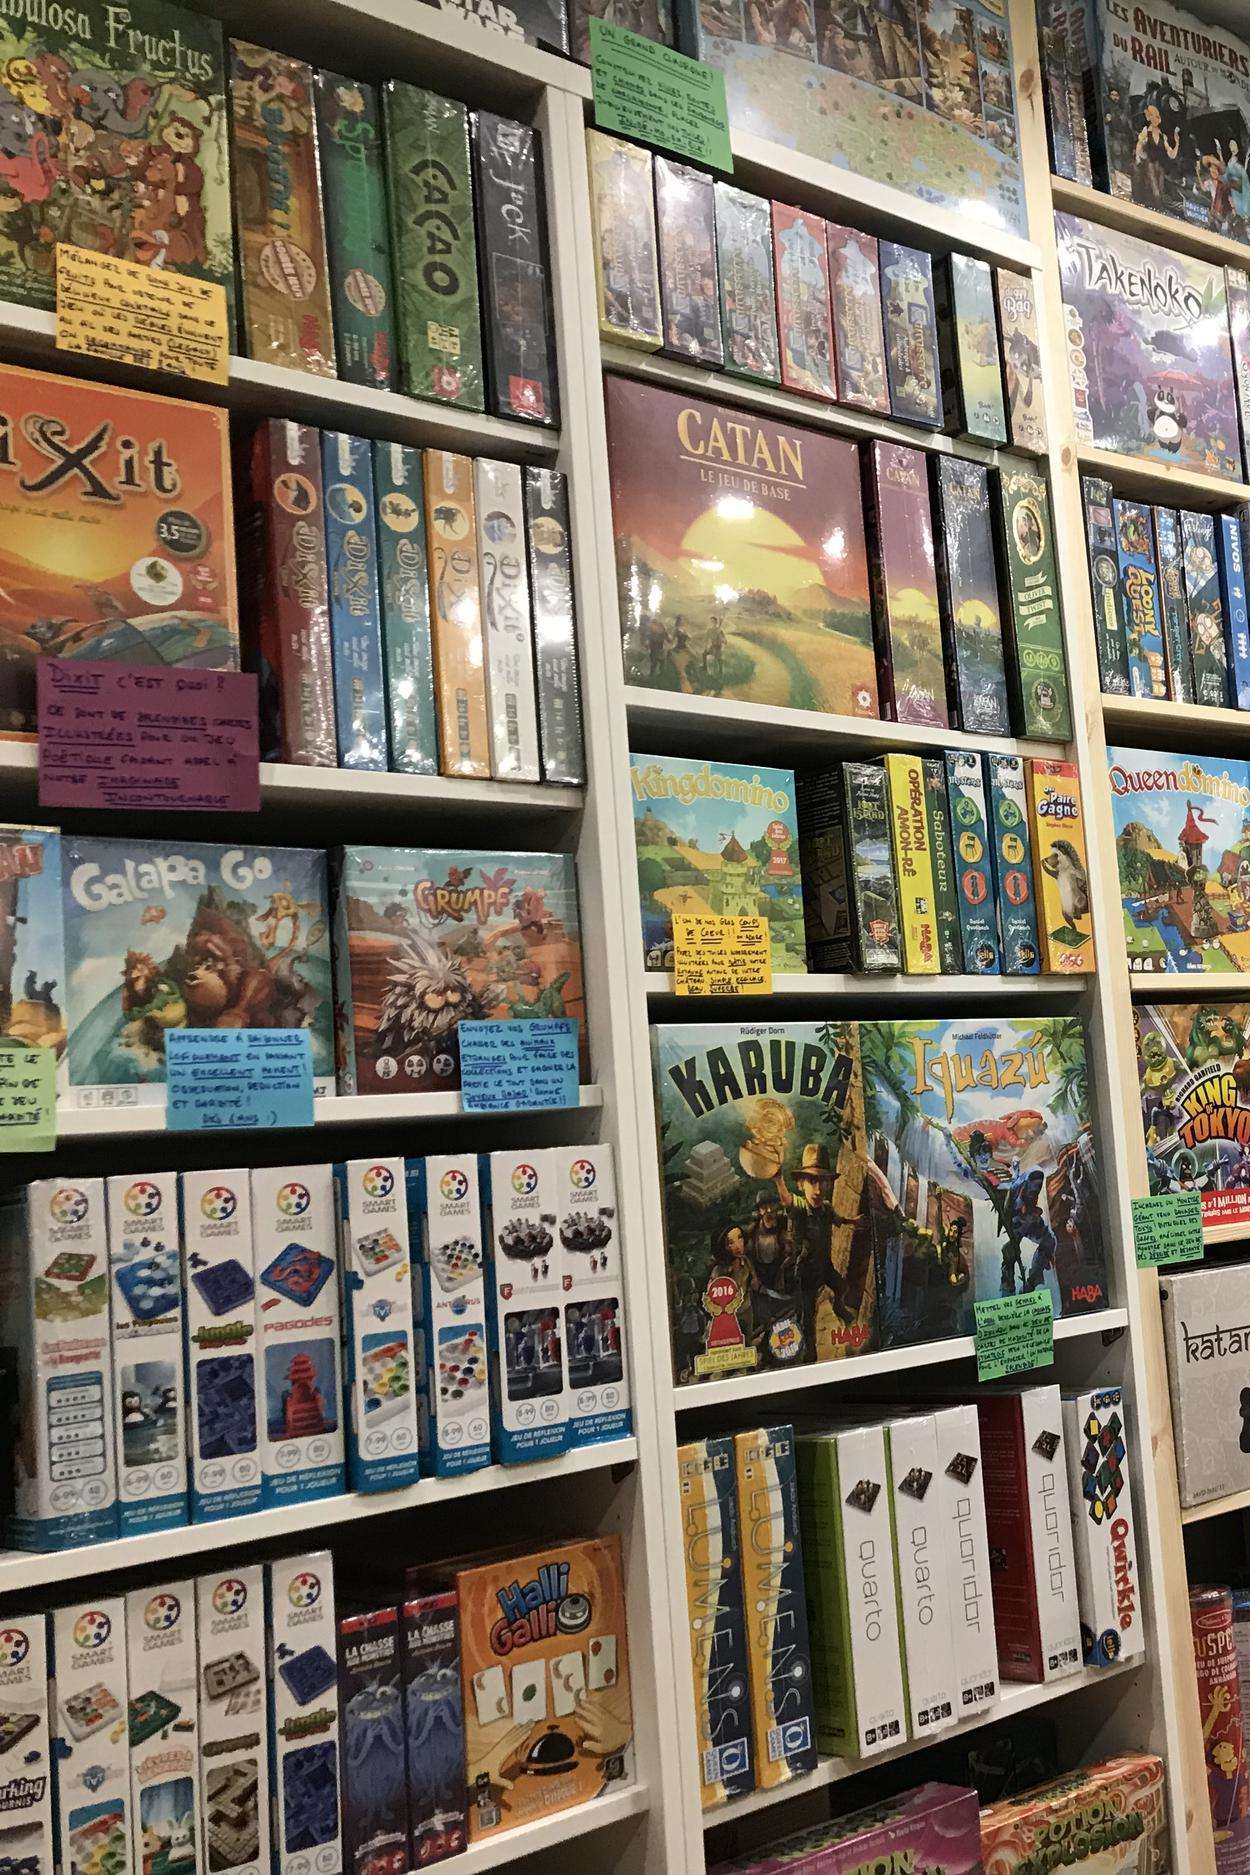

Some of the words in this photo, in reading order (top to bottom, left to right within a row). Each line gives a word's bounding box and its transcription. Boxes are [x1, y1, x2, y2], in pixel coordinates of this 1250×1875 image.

[0, 0, 92, 40] bulosa
[104, 5, 214, 81] Fructus
[1106, 0, 1129, 23] LES
[1133, 7, 1250, 78] AVENTURIERS
[1130, 36, 1177, 77] RAIL
[408, 158, 461, 297] CACAO
[1076, 244, 1203, 320] TAKENOKO
[677, 408, 805, 482] CATAN
[700, 469, 717, 484] LE
[718, 473, 740, 491] JEU
[743, 479, 759, 495] DE
[761, 482, 791, 501] BASE
[886, 466, 920, 487] CATAN
[630, 763, 789, 814] Kingdomino
[907, 768, 927, 851] OPÉRATION
[1037, 799, 1079, 819] Gagne
[1049, 792, 1076, 806] Paire
[896, 806, 917, 877] AMON-RÉ
[71, 854, 206, 912] Galapa
[220, 849, 272, 890] Go
[414, 880, 511, 924] GRUMPF
[740, 1026, 766, 1037] Rüdiger
[767, 1026, 785, 1036] Dorn
[669, 1039, 854, 1118] KARUBA
[909, 1031, 1050, 1123] Iguazú
[1181, 1072, 1238, 1118] KING
[1218, 1193, 1248, 1208] MILLION
[711, 1286, 734, 1299] 2016
[1071, 1284, 1103, 1303] HABA
[831, 1322, 871, 1348] HABA
[953, 1497, 983, 1633] quoridor
[1037, 1472, 1066, 1603] quoridor
[496, 1562, 570, 1623] Halli
[859, 1540, 884, 1642] quarto
[911, 1526, 936, 1627] quarto
[1110, 1517, 1136, 1631] Qwirkle
[360, 1635, 394, 1657] CHASSE
[421, 1620, 454, 1640] CHASSE
[490, 1601, 558, 1656] Galli
